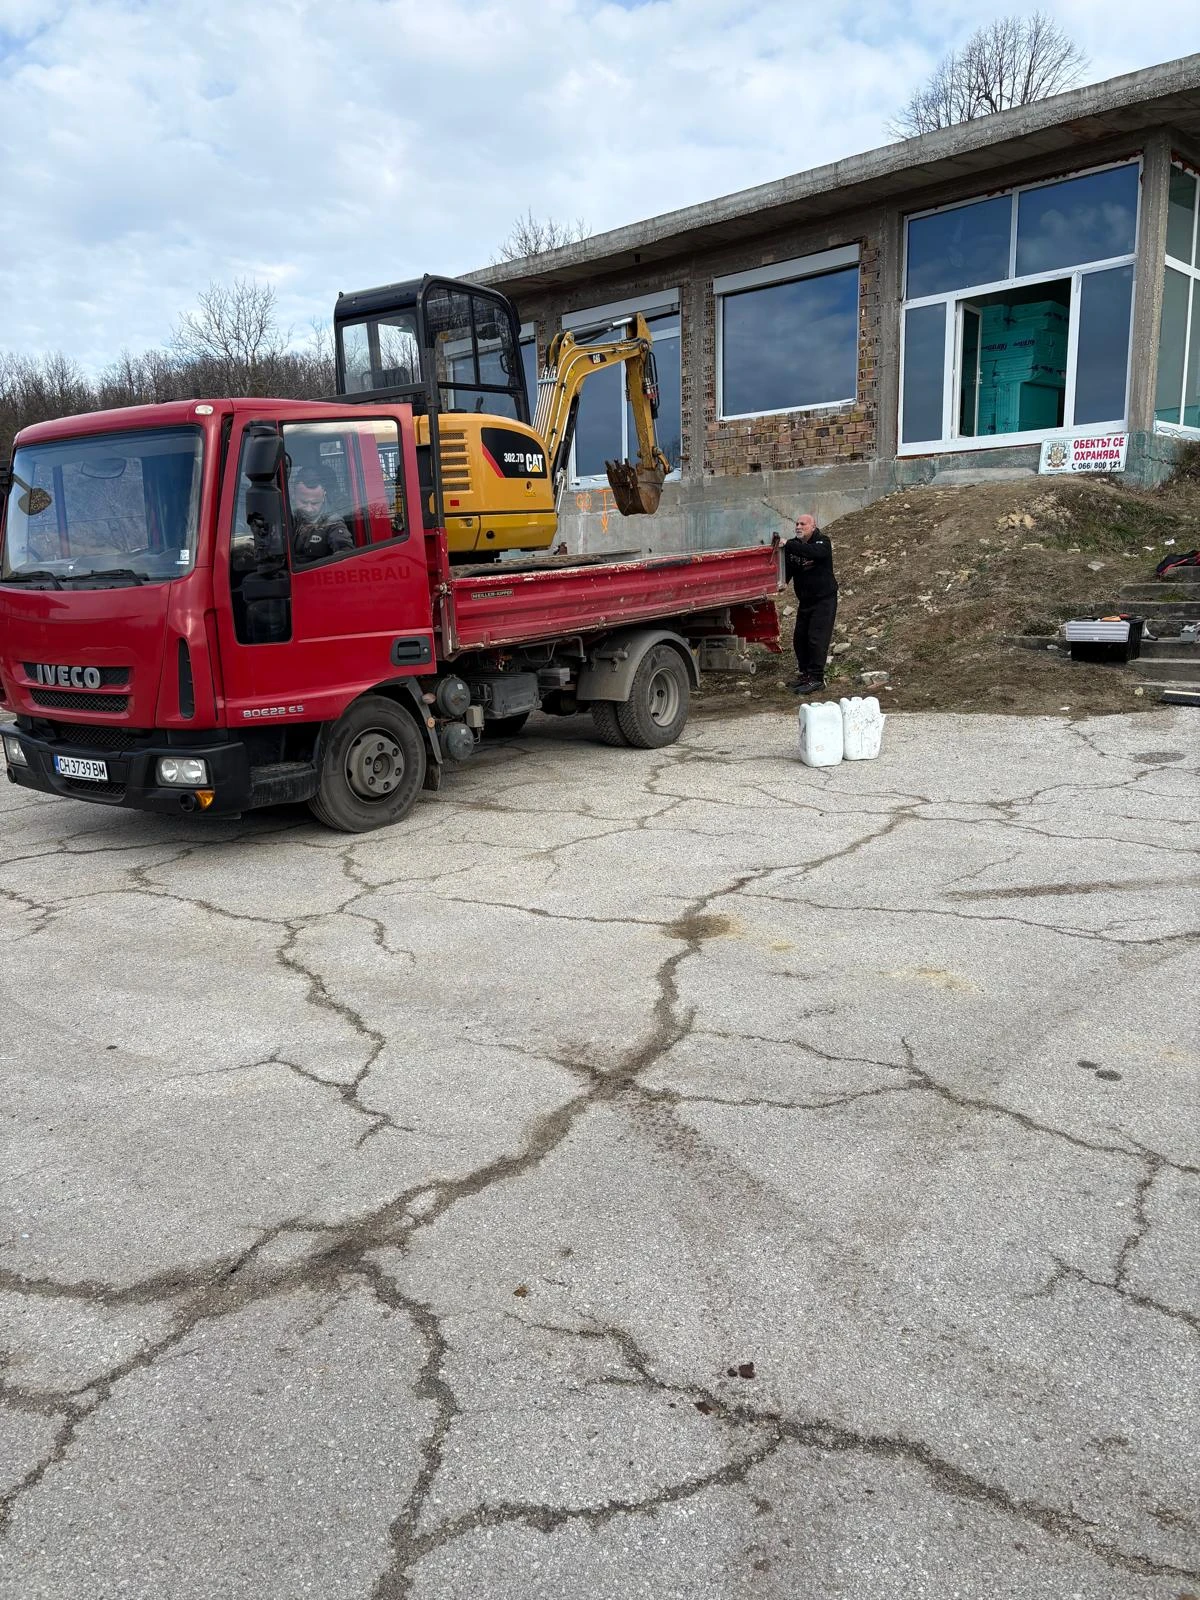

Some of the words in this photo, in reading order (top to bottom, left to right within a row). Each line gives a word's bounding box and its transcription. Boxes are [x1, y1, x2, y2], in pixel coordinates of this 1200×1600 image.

[1073, 438, 1111, 449] ОБЕКТЪТ
[1113, 437, 1125, 447] СЕ
[525, 453, 543, 473] CAT
[1074, 450, 1120, 461] ОХРАНЯВА
[36, 664, 101, 689] IVECO
